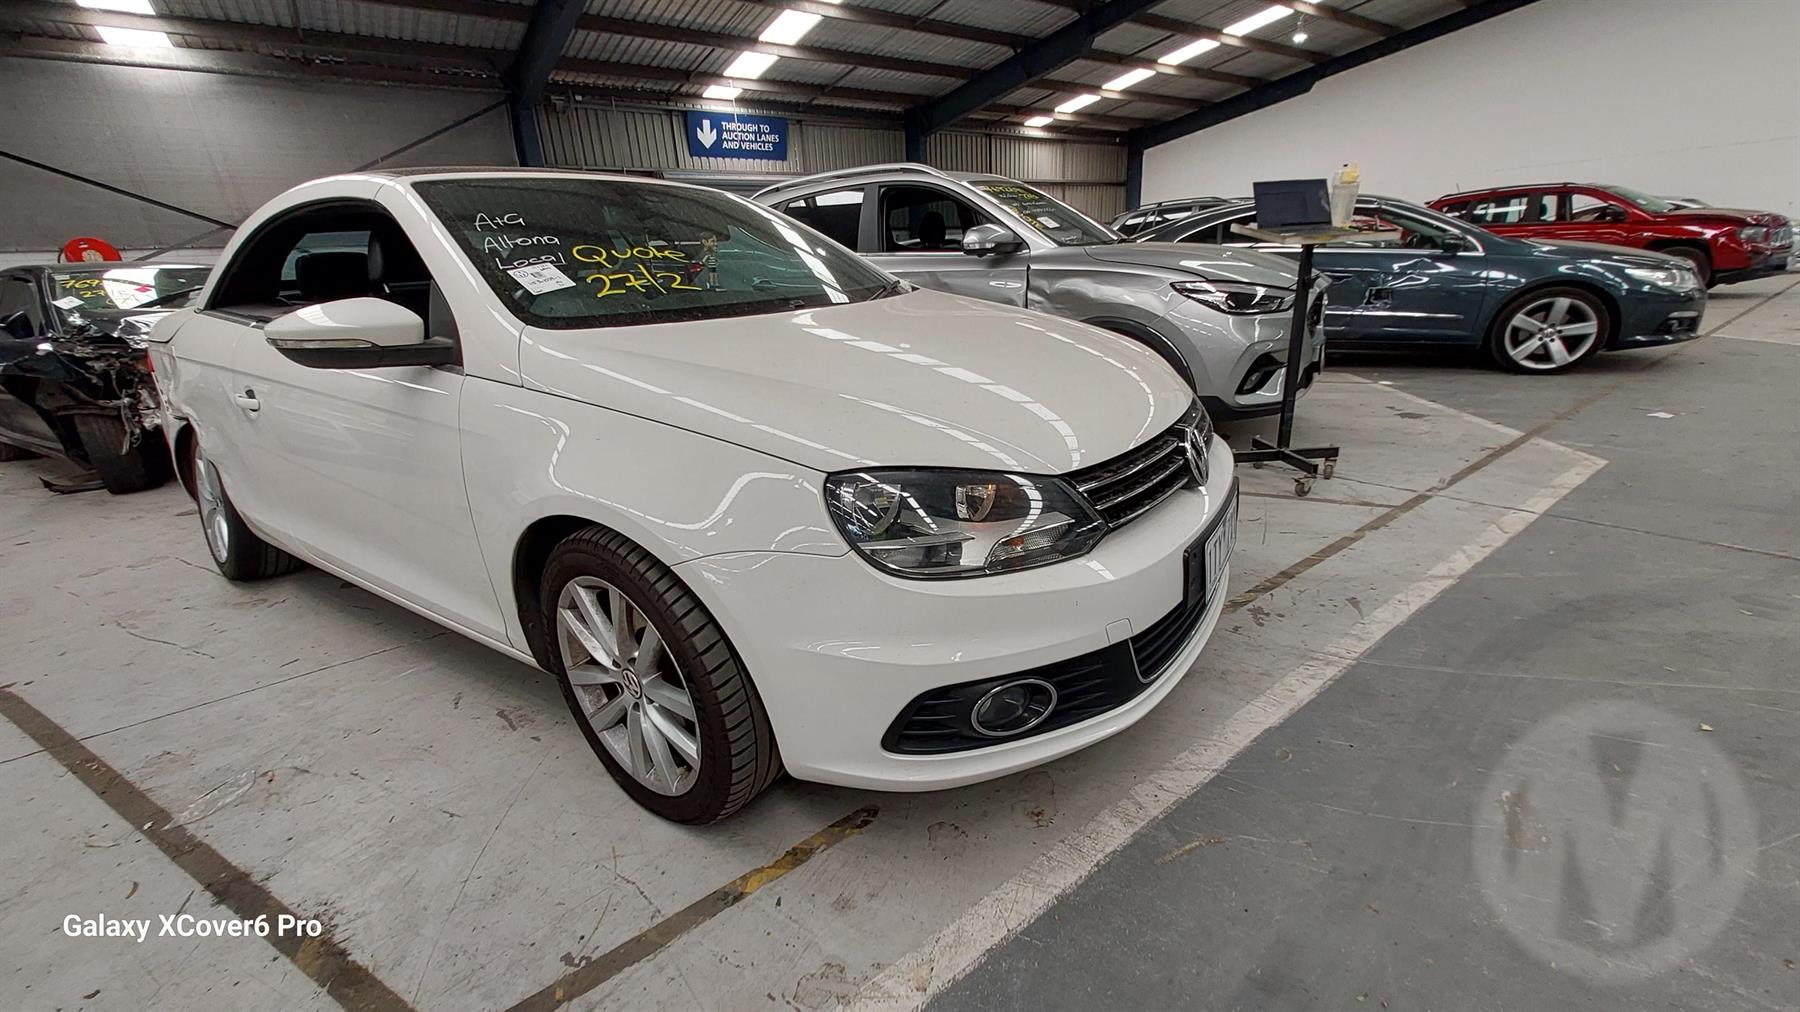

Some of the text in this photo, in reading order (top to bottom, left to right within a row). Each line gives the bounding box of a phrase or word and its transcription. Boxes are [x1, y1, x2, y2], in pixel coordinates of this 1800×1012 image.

[721, 122, 770, 133] THROUGH TO
[722, 132, 779, 143] AUCTION LANES
[722, 141, 773, 151] AND VEHICLES
[495, 252, 567, 270] Local
[586, 262, 703, 298] 27/2
